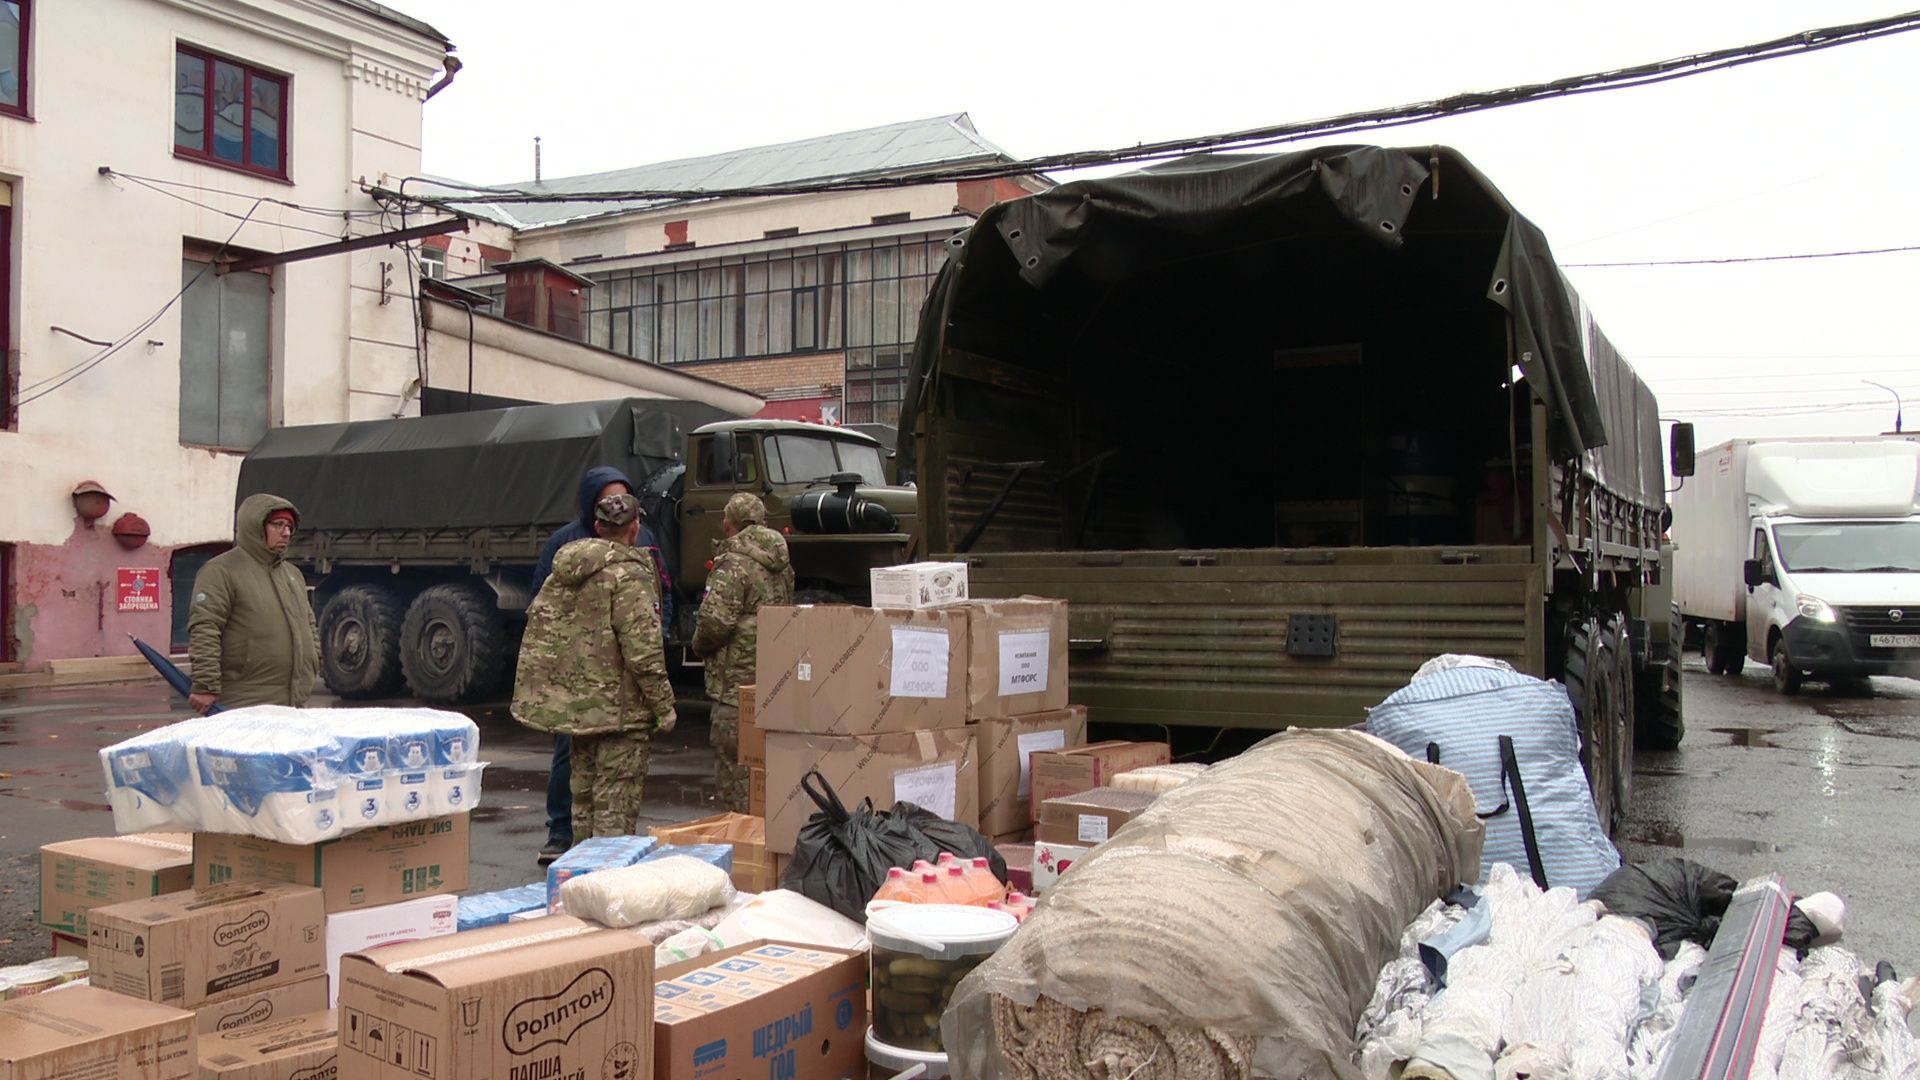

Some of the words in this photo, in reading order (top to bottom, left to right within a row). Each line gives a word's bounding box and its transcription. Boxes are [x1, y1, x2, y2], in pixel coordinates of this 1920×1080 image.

[119, 602, 159, 610] ЗАПРЕЩЕНА
[1010, 673, 1038, 685] МТФОРС
[409, 792, 418, 805] 3
[452, 786, 461, 798] 3
[366, 798, 376, 811] 3
[428, 820, 453, 836] БИГ
[752, 1001, 814, 1060] ЩЕДРЫЙ
[769, 1048, 796, 1080] ГОД
